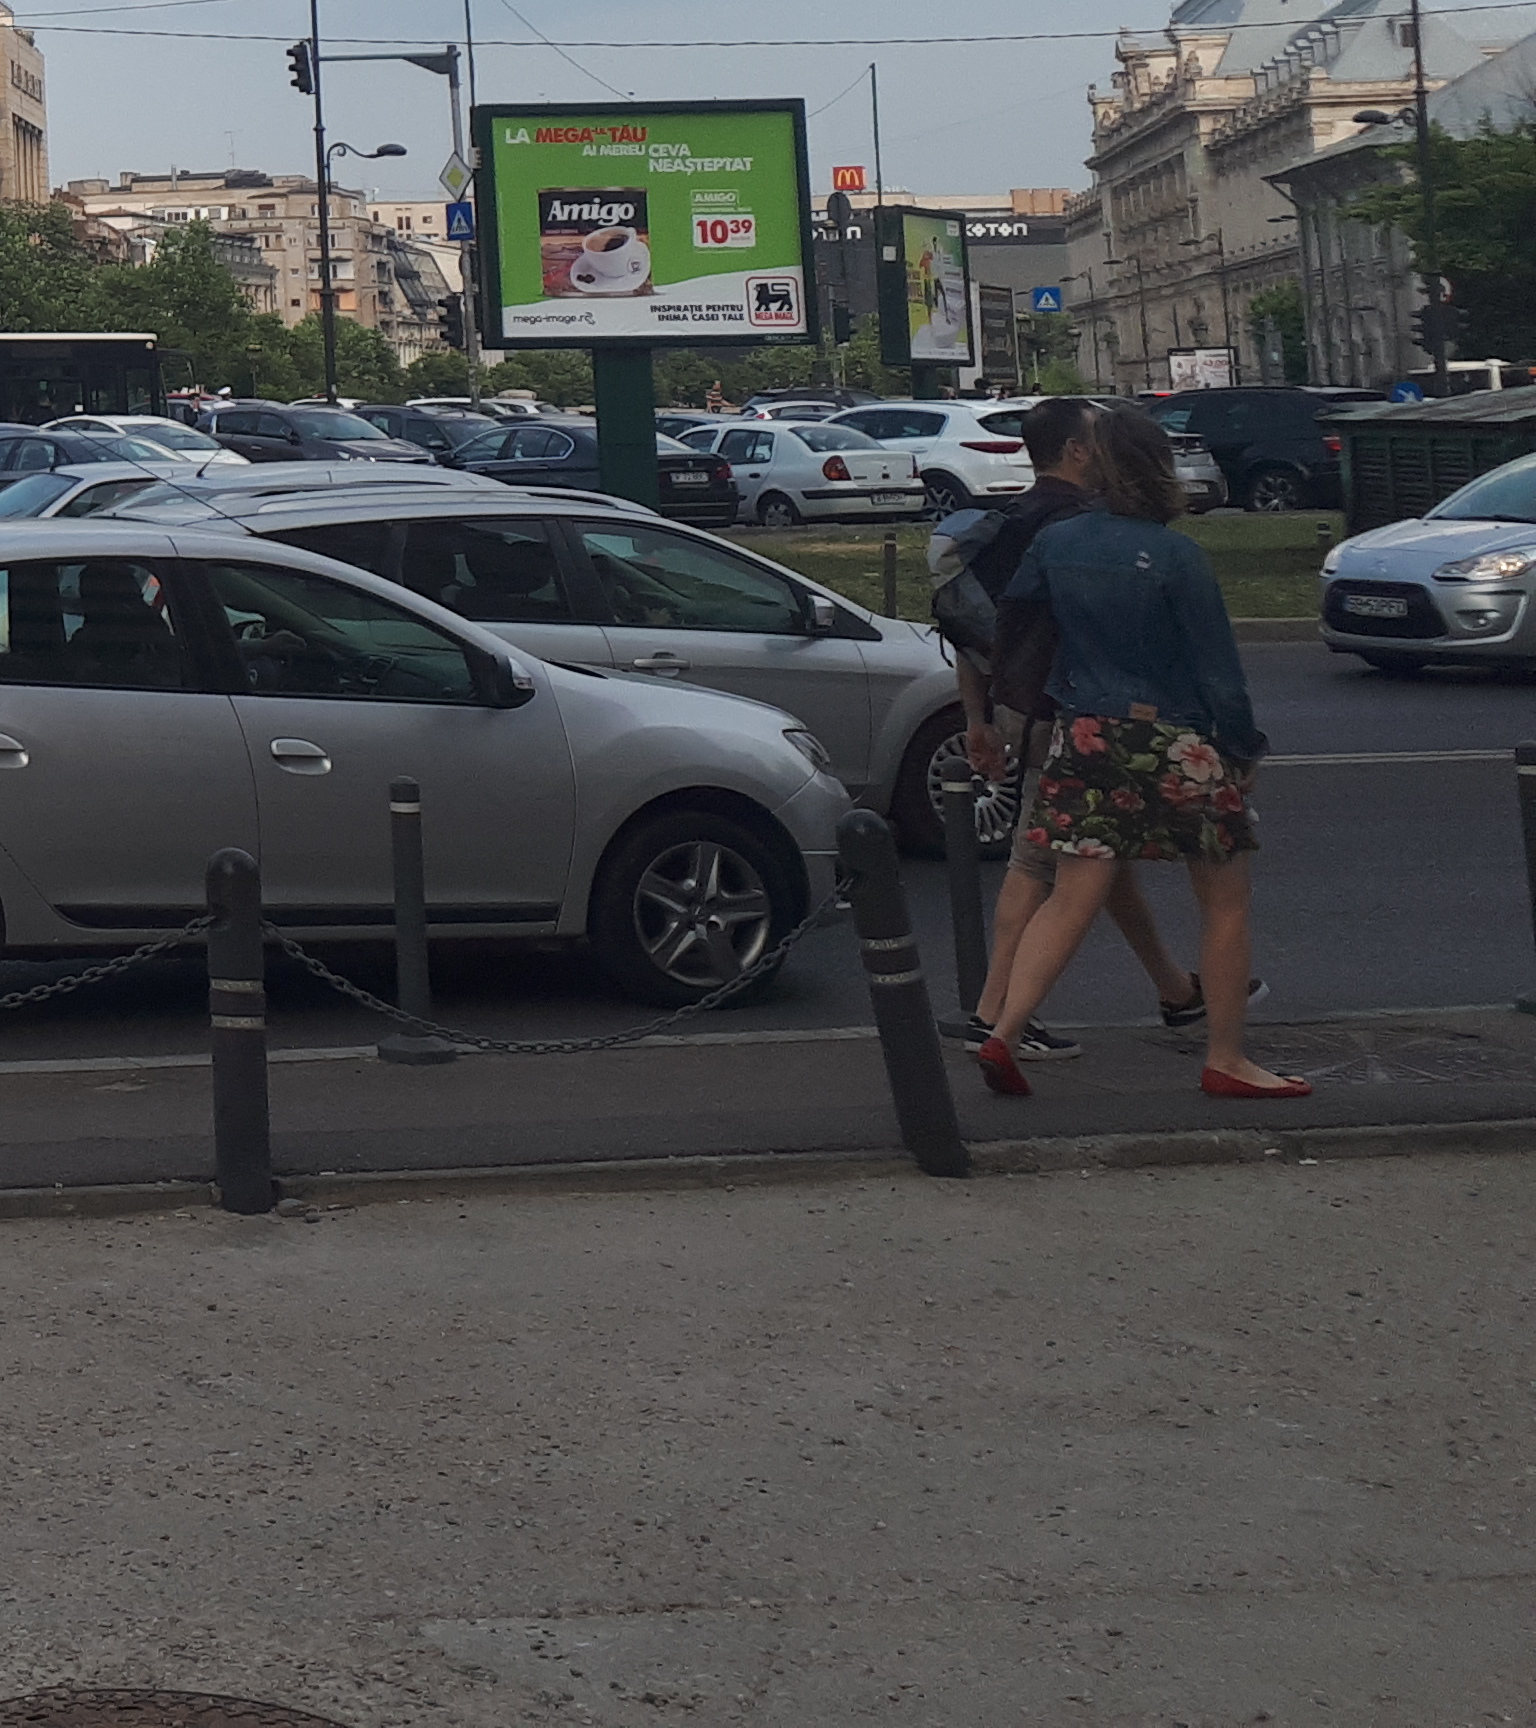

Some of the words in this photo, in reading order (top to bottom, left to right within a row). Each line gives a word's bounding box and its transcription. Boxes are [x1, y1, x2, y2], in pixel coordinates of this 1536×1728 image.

[505, 128, 530, 144] LA
[582, 145, 596, 156] AI
[600, 145, 645, 156] MEREU
[648, 144, 691, 157] CEVA
[695, 192, 736, 202] AMIGO
[548, 197, 635, 225] Amigo
[706, 304, 744, 312] PENTRU
[722, 313, 744, 321] TALE
[755, 312, 773, 320] MEGA
